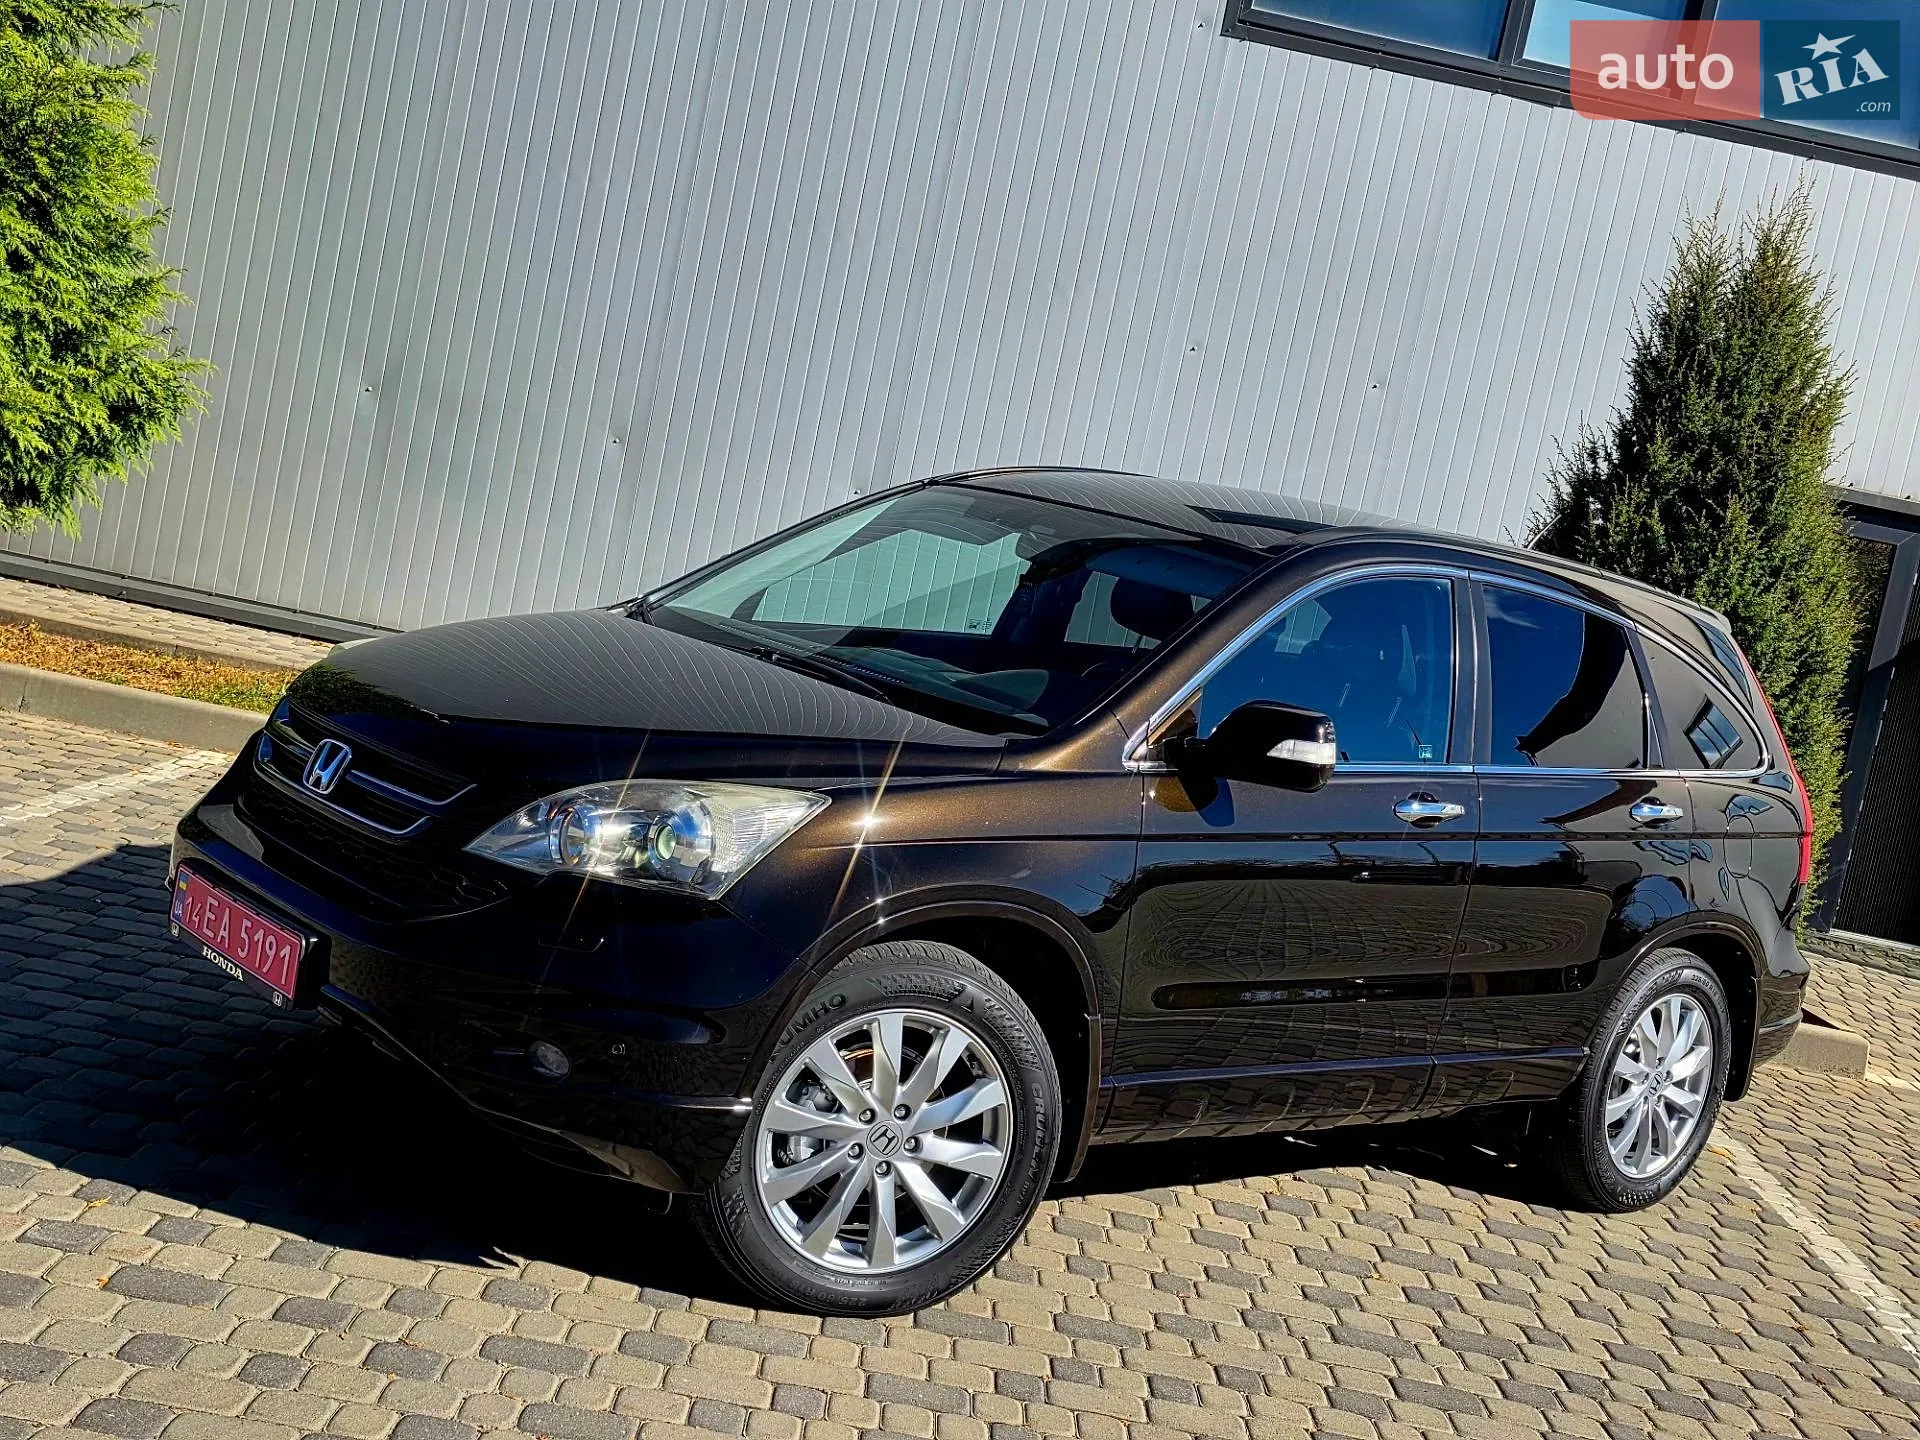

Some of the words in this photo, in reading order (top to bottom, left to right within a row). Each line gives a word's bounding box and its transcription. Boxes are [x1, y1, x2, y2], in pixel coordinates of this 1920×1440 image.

[174, 901, 183, 918] UA
[202, 946, 244, 981] HONDA
[237, 918, 292, 985] 5191
